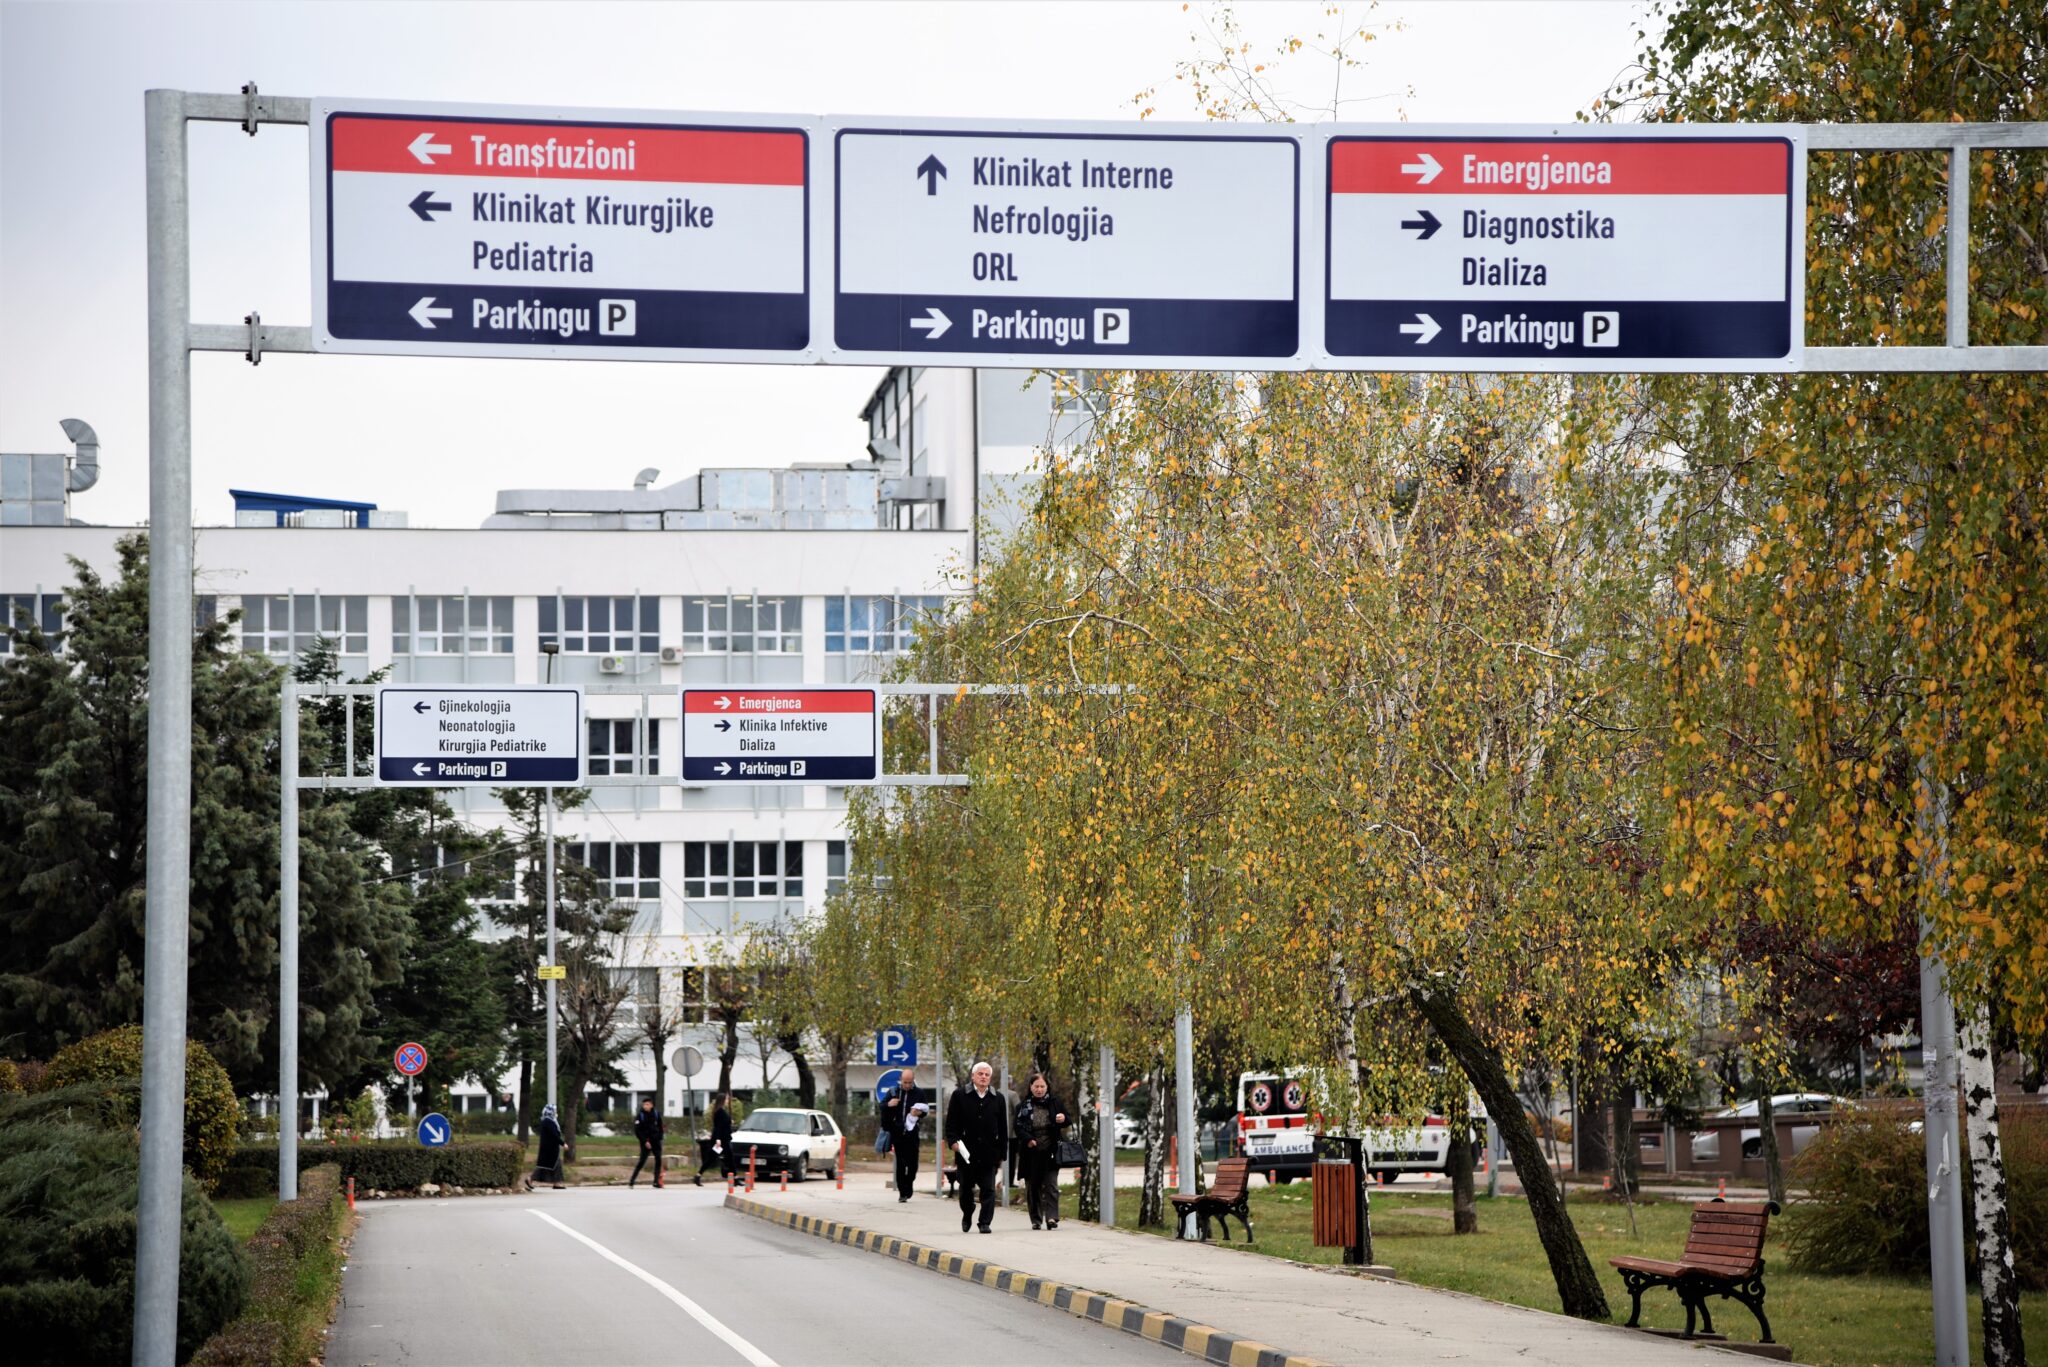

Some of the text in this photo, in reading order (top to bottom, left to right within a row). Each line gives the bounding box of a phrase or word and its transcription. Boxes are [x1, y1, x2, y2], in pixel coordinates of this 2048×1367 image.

[471, 135, 635, 170] Transfuzioni
[972, 157, 1173, 190] Klinikat Interne
[1463, 154, 1611, 190] Emergjenca
[472, 192, 714, 233] Klinikat Kirurgjike
[973, 205, 1113, 241] Nefrologjia
[1463, 209, 1615, 244] Diagnostika
[473, 241, 594, 273] Pediatria
[973, 252, 1017, 281] ORL
[1463, 257, 1547, 286] Dializa
[472, 298, 627, 337] Parkingu P
[972, 308, 1121, 346] Parkingu P
[1461, 313, 1610, 350] Parkingu P
[439, 700, 511, 715] Gjinekologjia
[739, 697, 802, 712] Emergjenca
[439, 719, 516, 735] Neonatologjia
[739, 719, 828, 732] Klinika Infektive
[439, 738, 547, 754] Kirurgjia Pediatrike
[739, 738, 776, 752] Dializa
[439, 762, 487, 778] Parkingu
[739, 761, 788, 777] Parkingu
[883, 1031, 904, 1061] P
[1254, 1144, 1310, 1154] AMBULANCE
